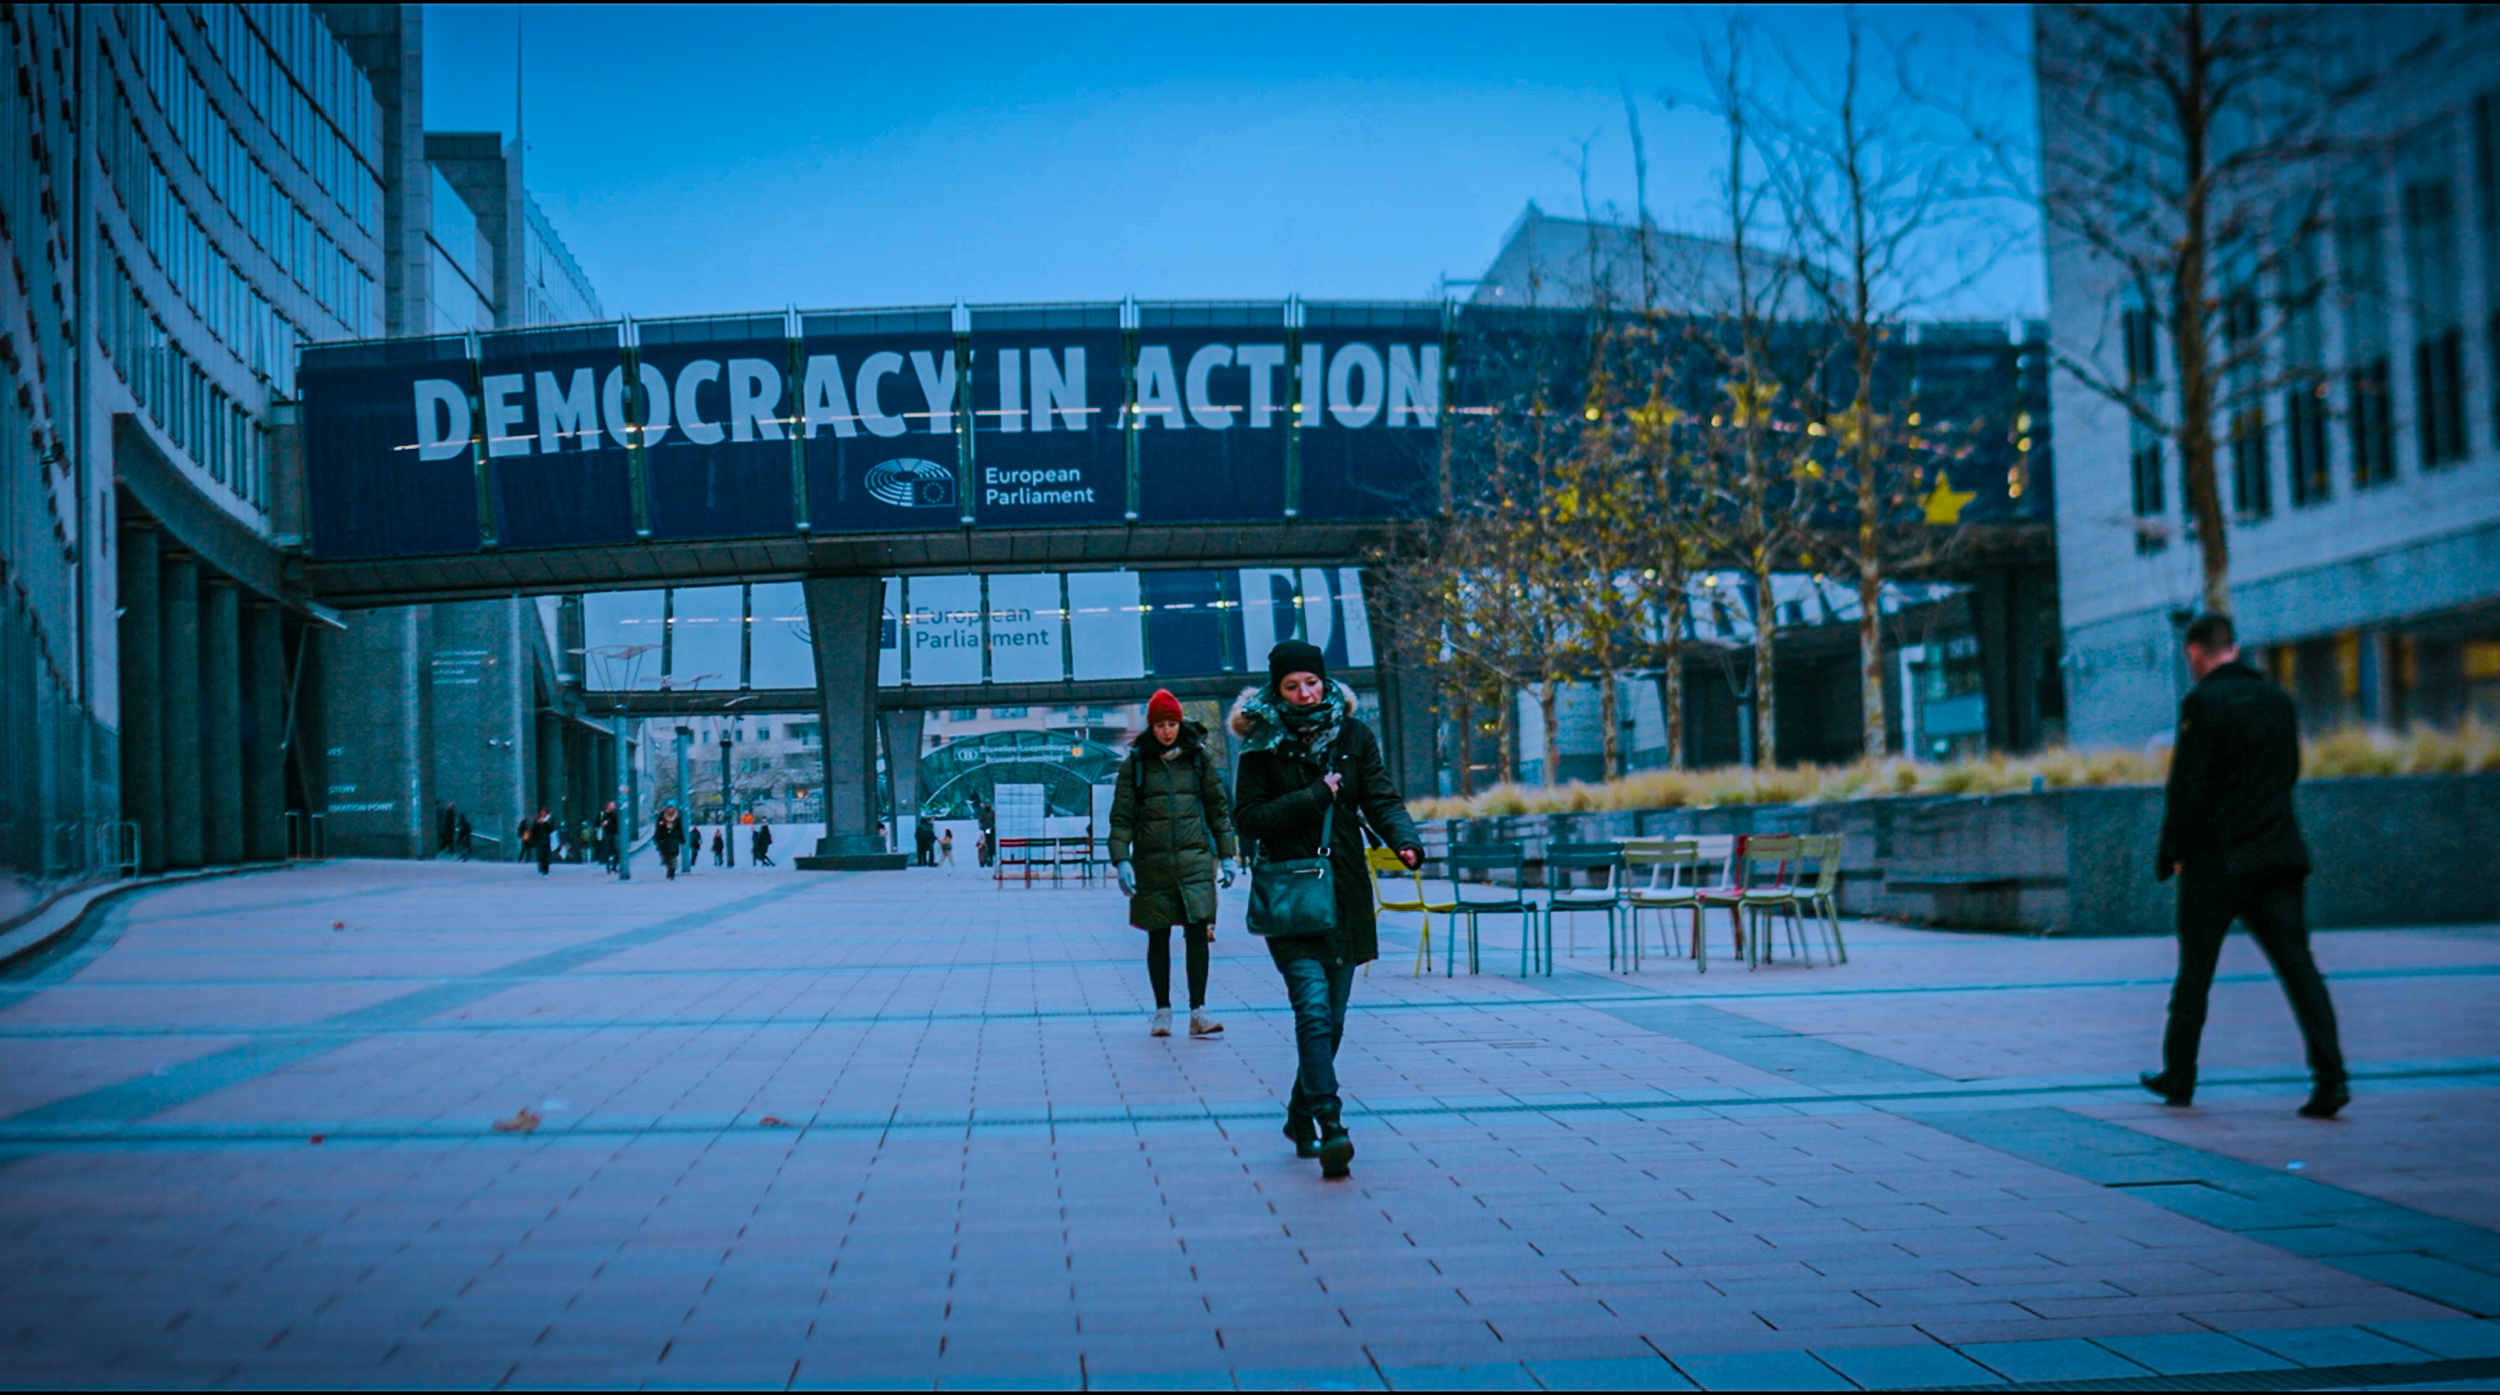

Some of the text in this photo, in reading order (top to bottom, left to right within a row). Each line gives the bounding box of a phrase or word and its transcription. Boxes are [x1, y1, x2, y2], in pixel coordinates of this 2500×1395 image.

[413, 343, 1441, 462] DEMOCRACY IN ACTION
[985, 466, 1081, 486] European
[985, 487, 1095, 505] Parliament
[915, 607, 1031, 627] European
[916, 629, 1049, 648] Parliament
